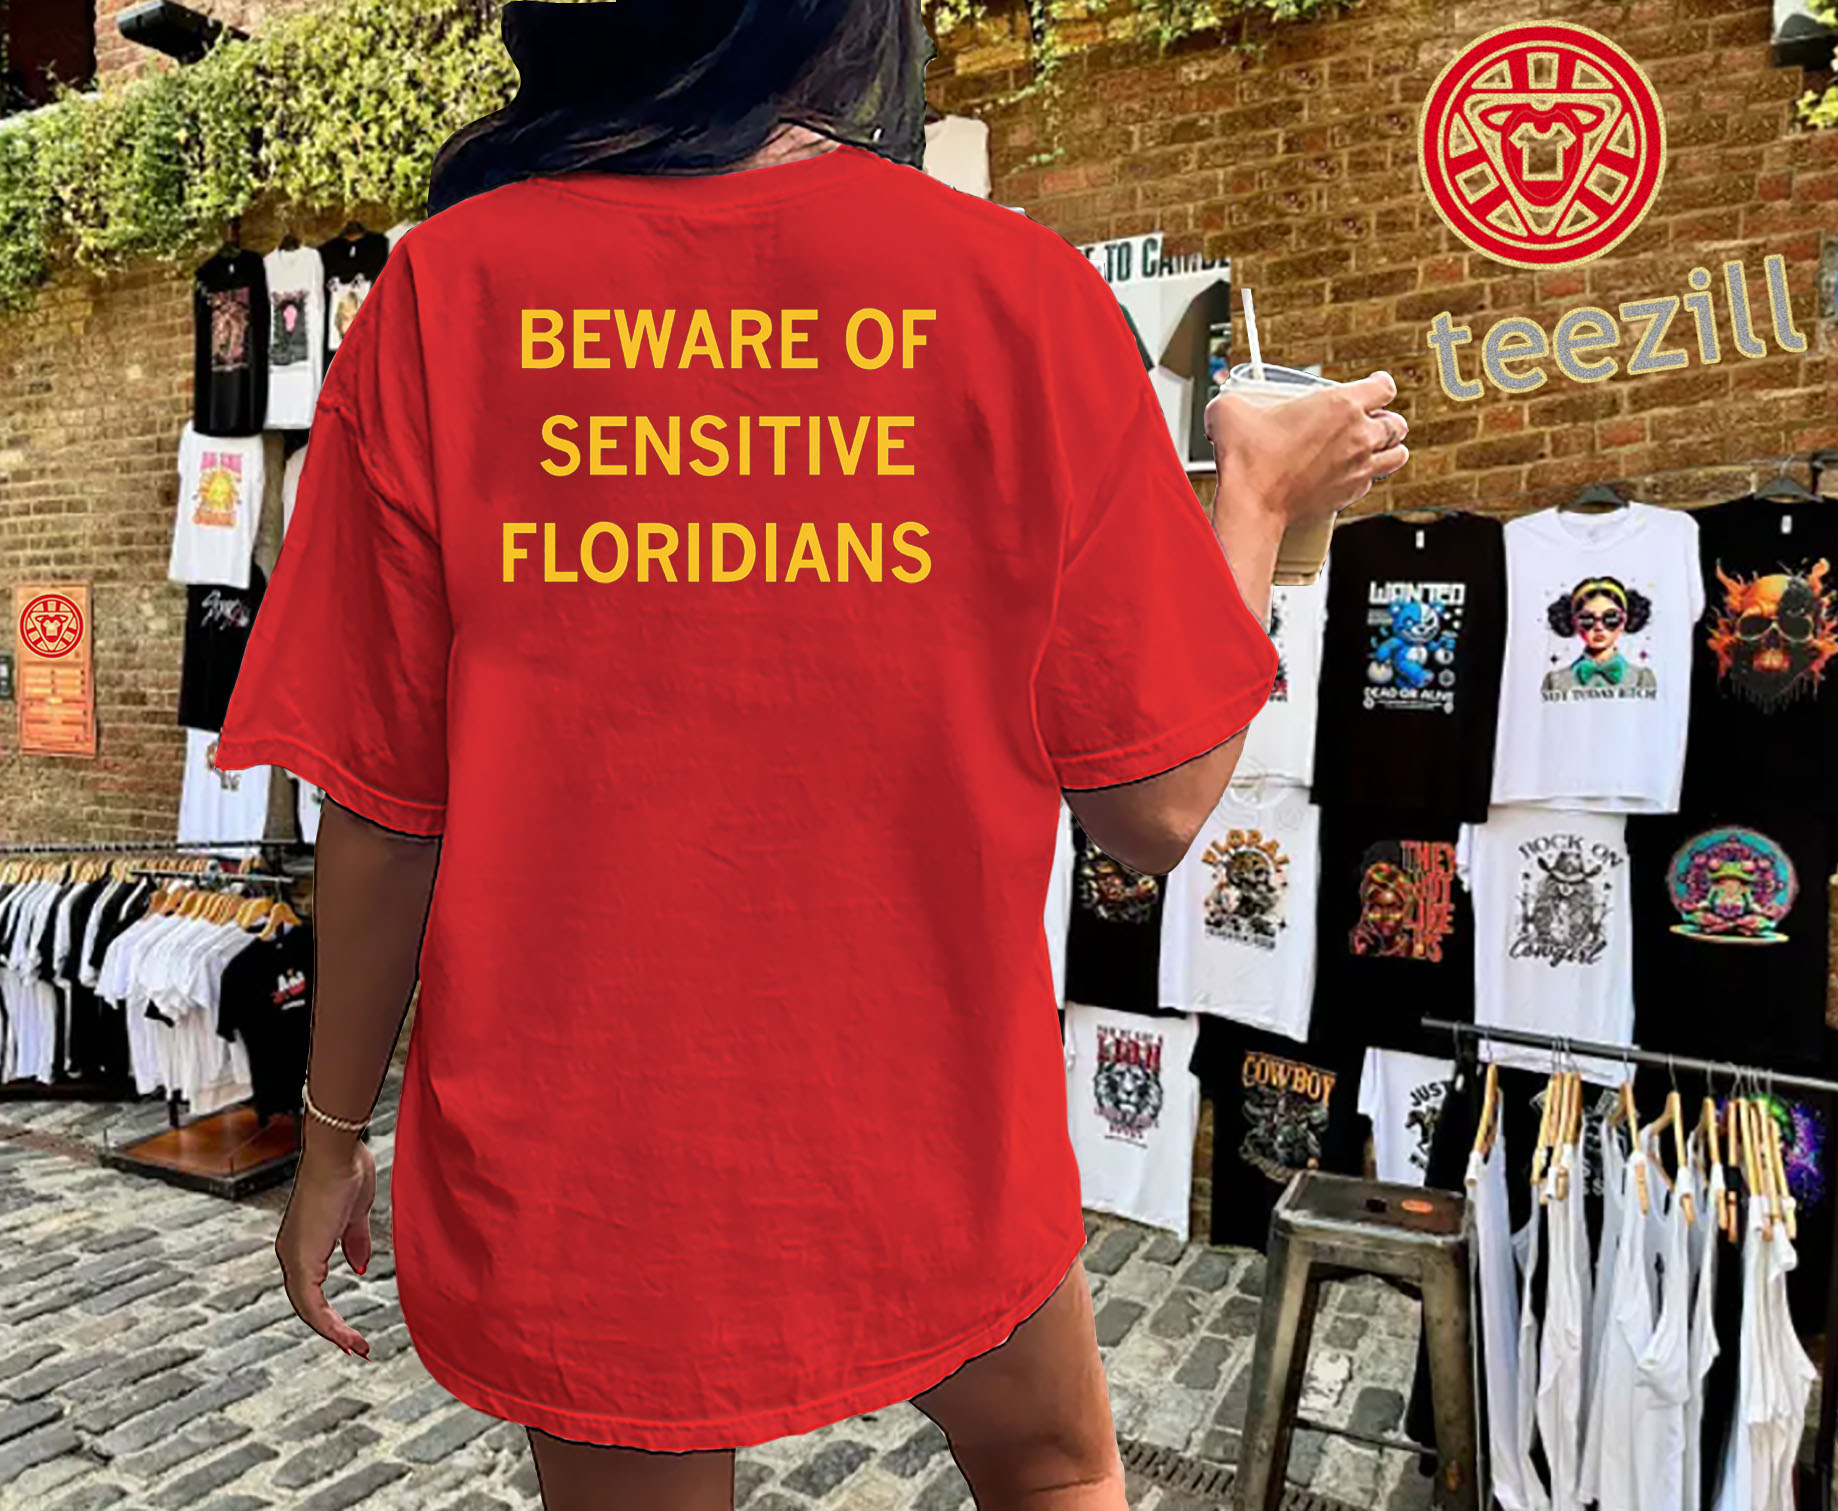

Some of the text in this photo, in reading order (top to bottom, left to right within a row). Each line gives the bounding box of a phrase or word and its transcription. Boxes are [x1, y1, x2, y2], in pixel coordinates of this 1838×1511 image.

[1104, 240, 1133, 283] TO
[521, 307, 938, 370] BEWARE OF
[1427, 254, 1808, 402] teezill
[540, 414, 915, 477] SENSITIVE
[502, 521, 932, 584] FLORIDIANS
[1368, 580, 1466, 606] WANTED
[1242, 1053, 1336, 1108] COWBOY
